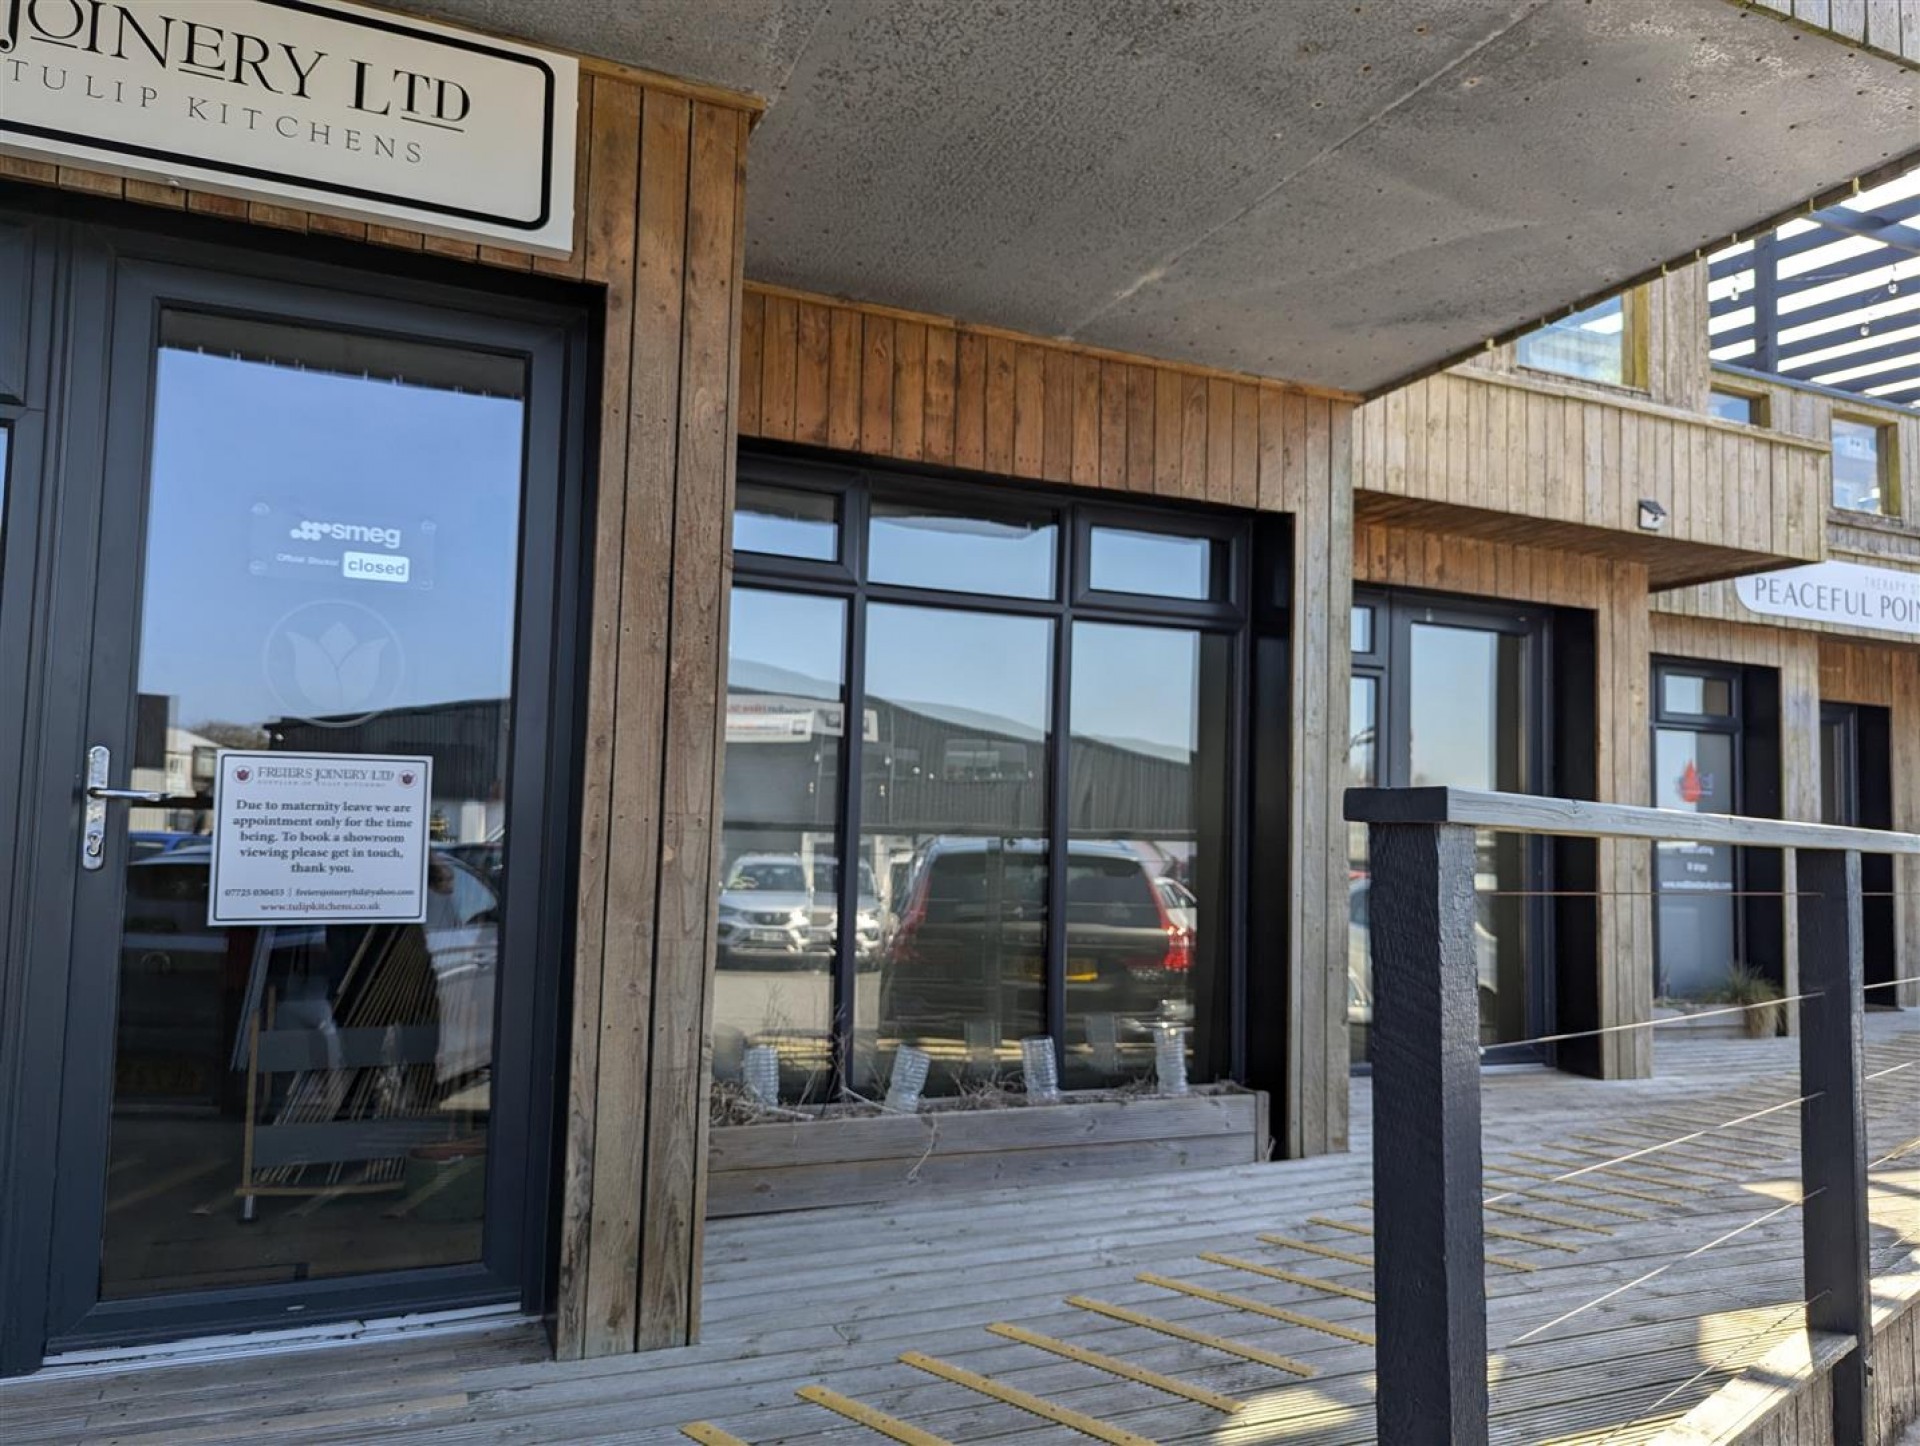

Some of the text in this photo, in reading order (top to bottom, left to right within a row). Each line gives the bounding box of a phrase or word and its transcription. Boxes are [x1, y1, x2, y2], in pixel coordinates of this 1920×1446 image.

[0, 0, 471, 126] JOINERY LTD
[7, 58, 424, 165] TULIP KITCHENS
[330, 522, 401, 549] smeg
[347, 558, 406, 576] closed
[1864, 575, 1907, 592] THERAPY
[1754, 576, 1873, 618] PEACEFUL
[258, 766, 395, 782] FREIERS JOINERY LTD
[236, 799, 412, 814] Due to maternity leave we are
[233, 815, 413, 829] appointment only for the time
[240, 831, 278, 843] being.
[282, 832, 297, 842] To
[300, 832, 330, 842] book
[343, 833, 405, 843] showroom
[240, 848, 404, 860] viewing please get in touch,
[291, 863, 354, 875] thank you.
[261, 901, 381, 914] www.tulipkitchens.co.uk
